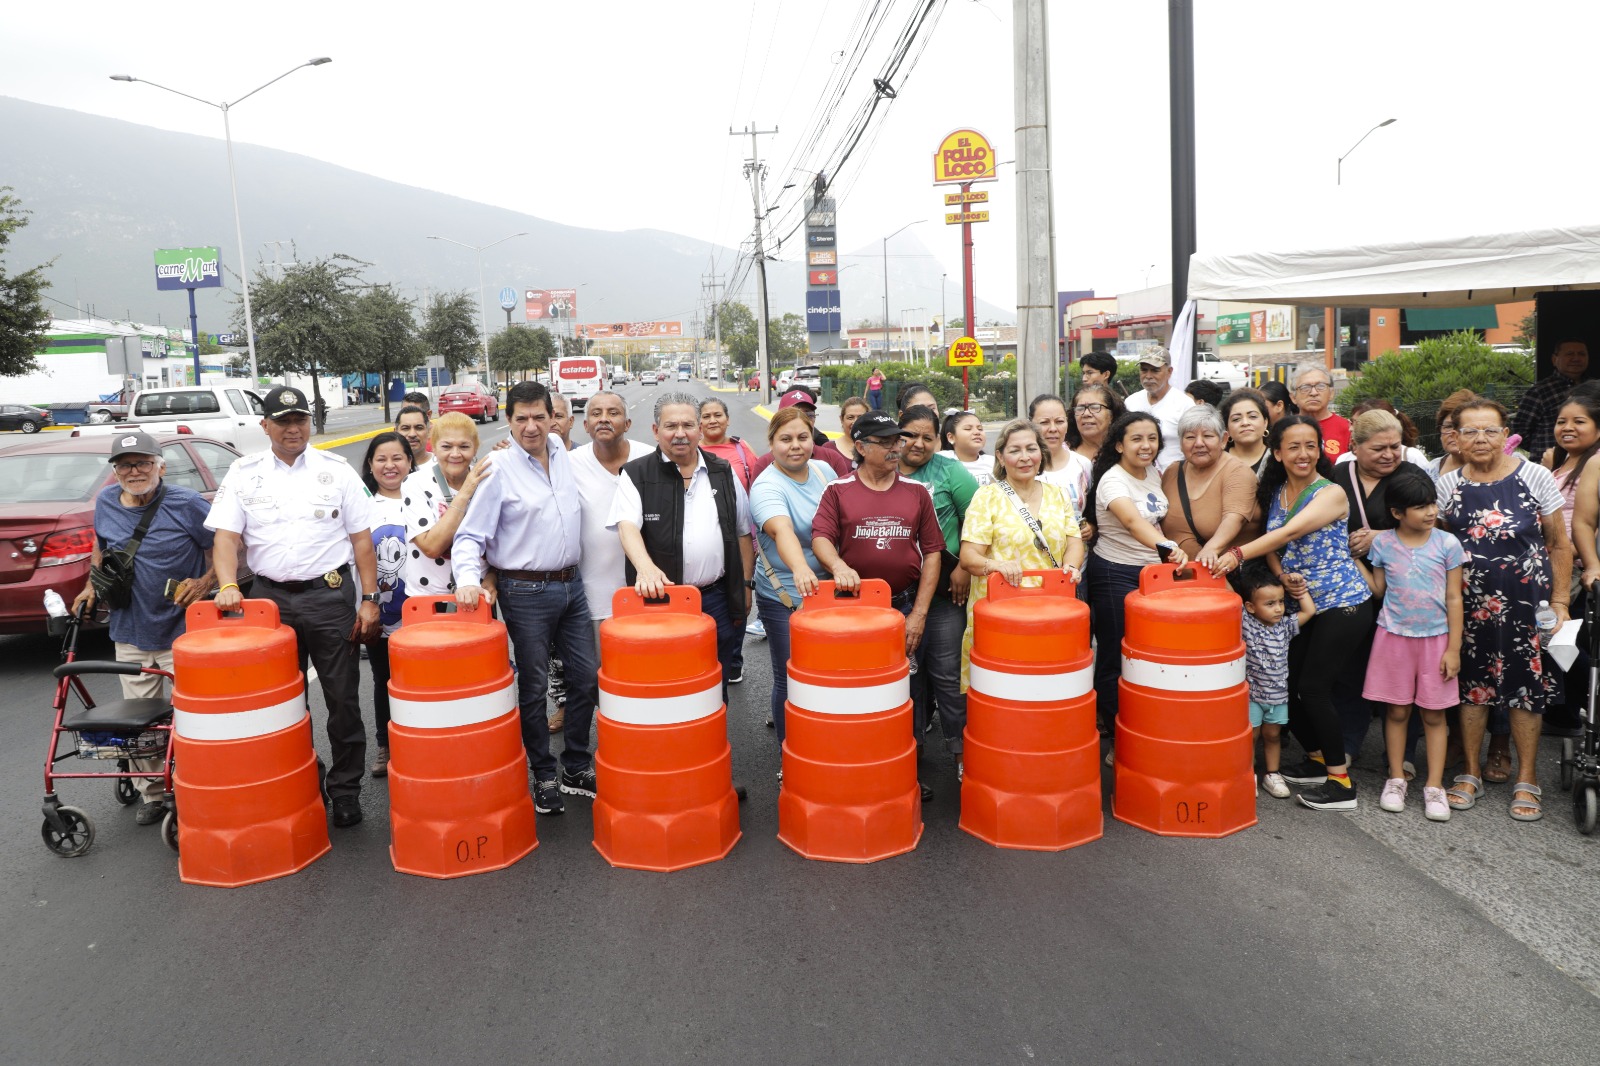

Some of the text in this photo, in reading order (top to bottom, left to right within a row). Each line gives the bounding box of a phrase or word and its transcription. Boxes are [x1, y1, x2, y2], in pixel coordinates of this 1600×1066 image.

[958, 138, 971, 147] EL
[943, 147, 987, 163] POLLO
[944, 161, 986, 177] LOCO
[966, 193, 986, 201] LOCO
[807, 305, 841, 315] cinépolis
[956, 342, 977, 350] AUTO
[954, 350, 978, 358] LOCO
[561, 366, 595, 374] estafeta
[876, 537, 891, 550] 5K
